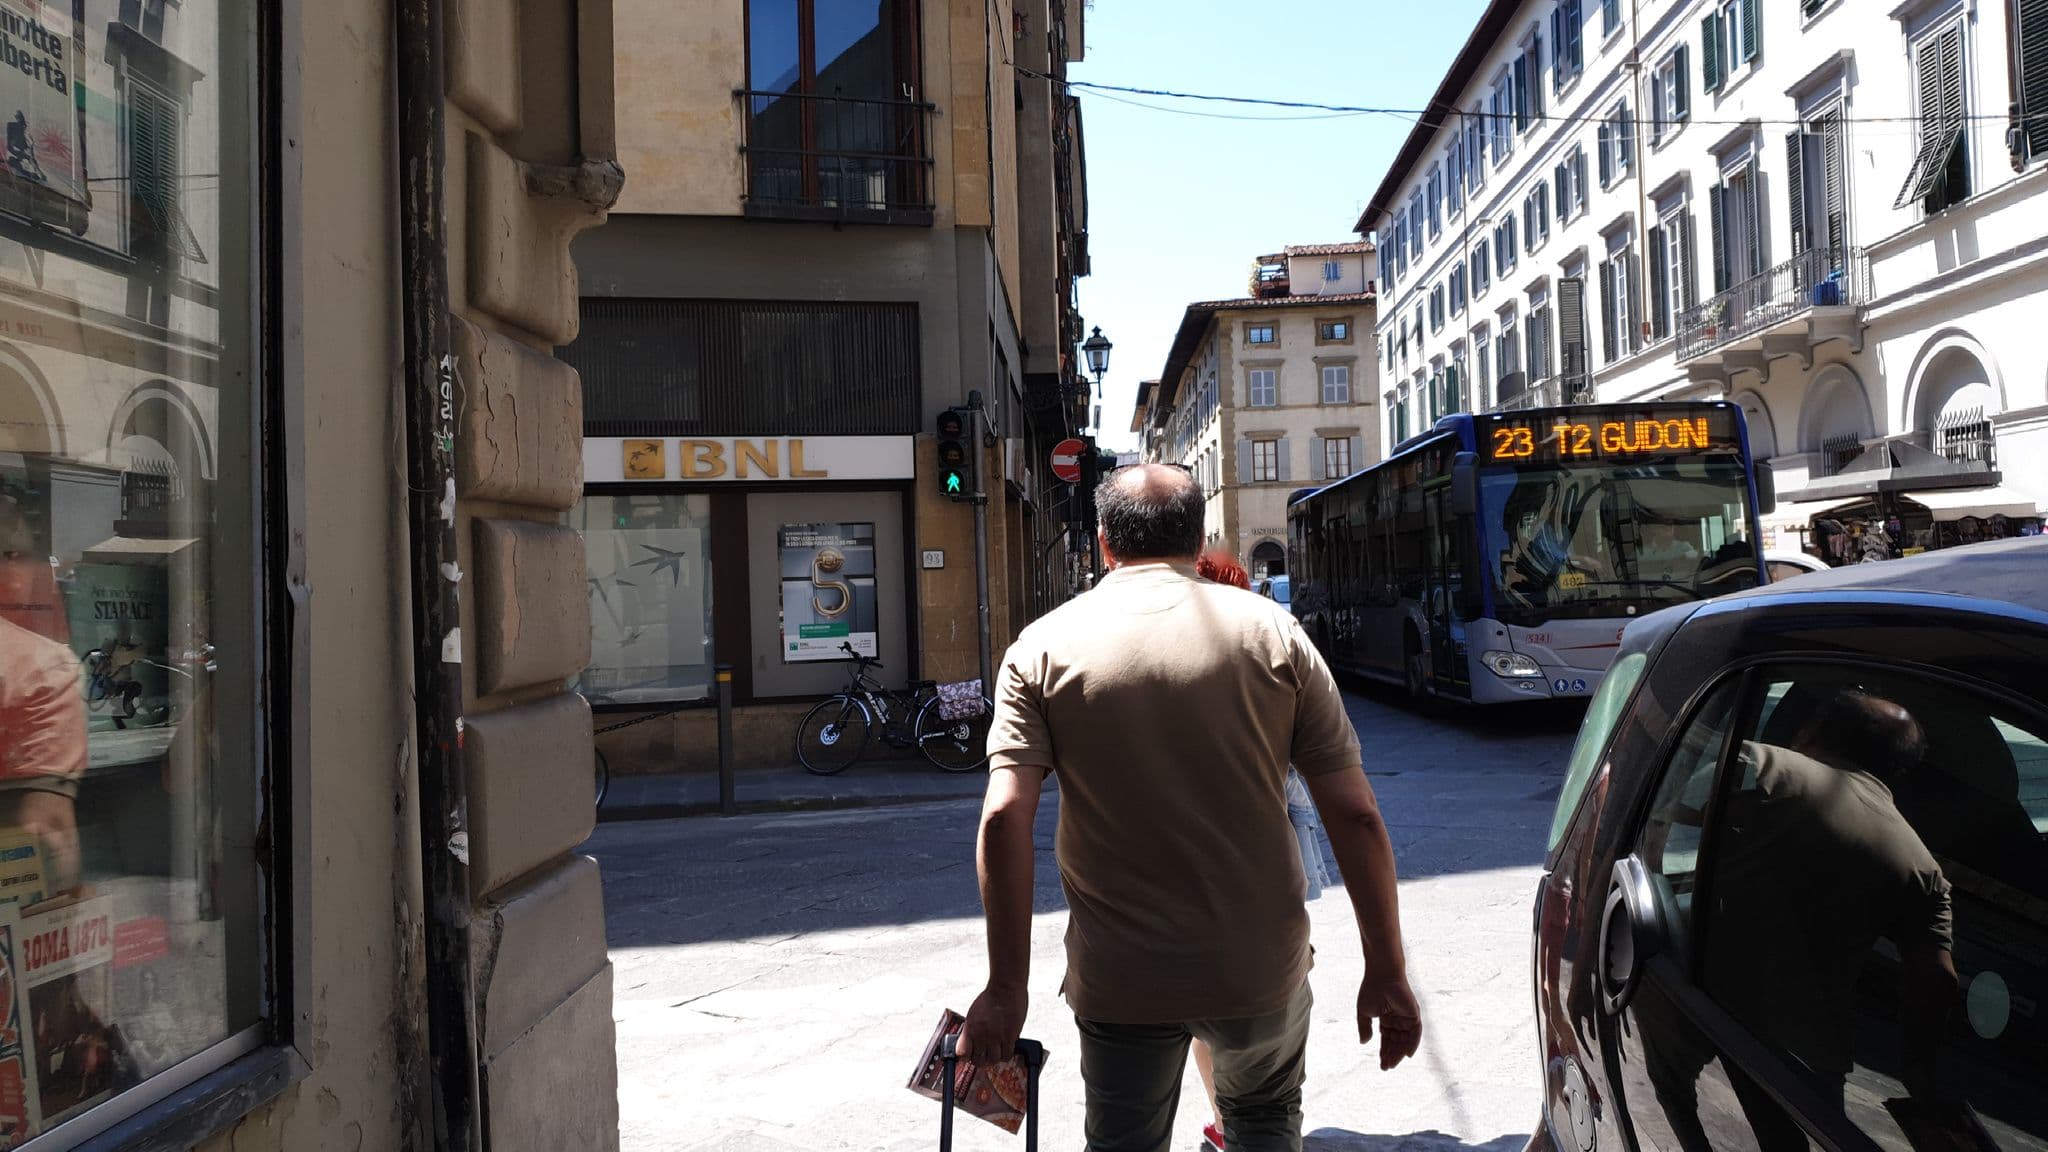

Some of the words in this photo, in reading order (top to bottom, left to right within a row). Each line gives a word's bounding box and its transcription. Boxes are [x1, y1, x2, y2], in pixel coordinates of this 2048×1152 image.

[1494, 427, 1535, 458] 23
[1553, 423, 1593, 454] T2
[1601, 417, 1709, 452] GUIDONI
[680, 439, 828, 478] BNL
